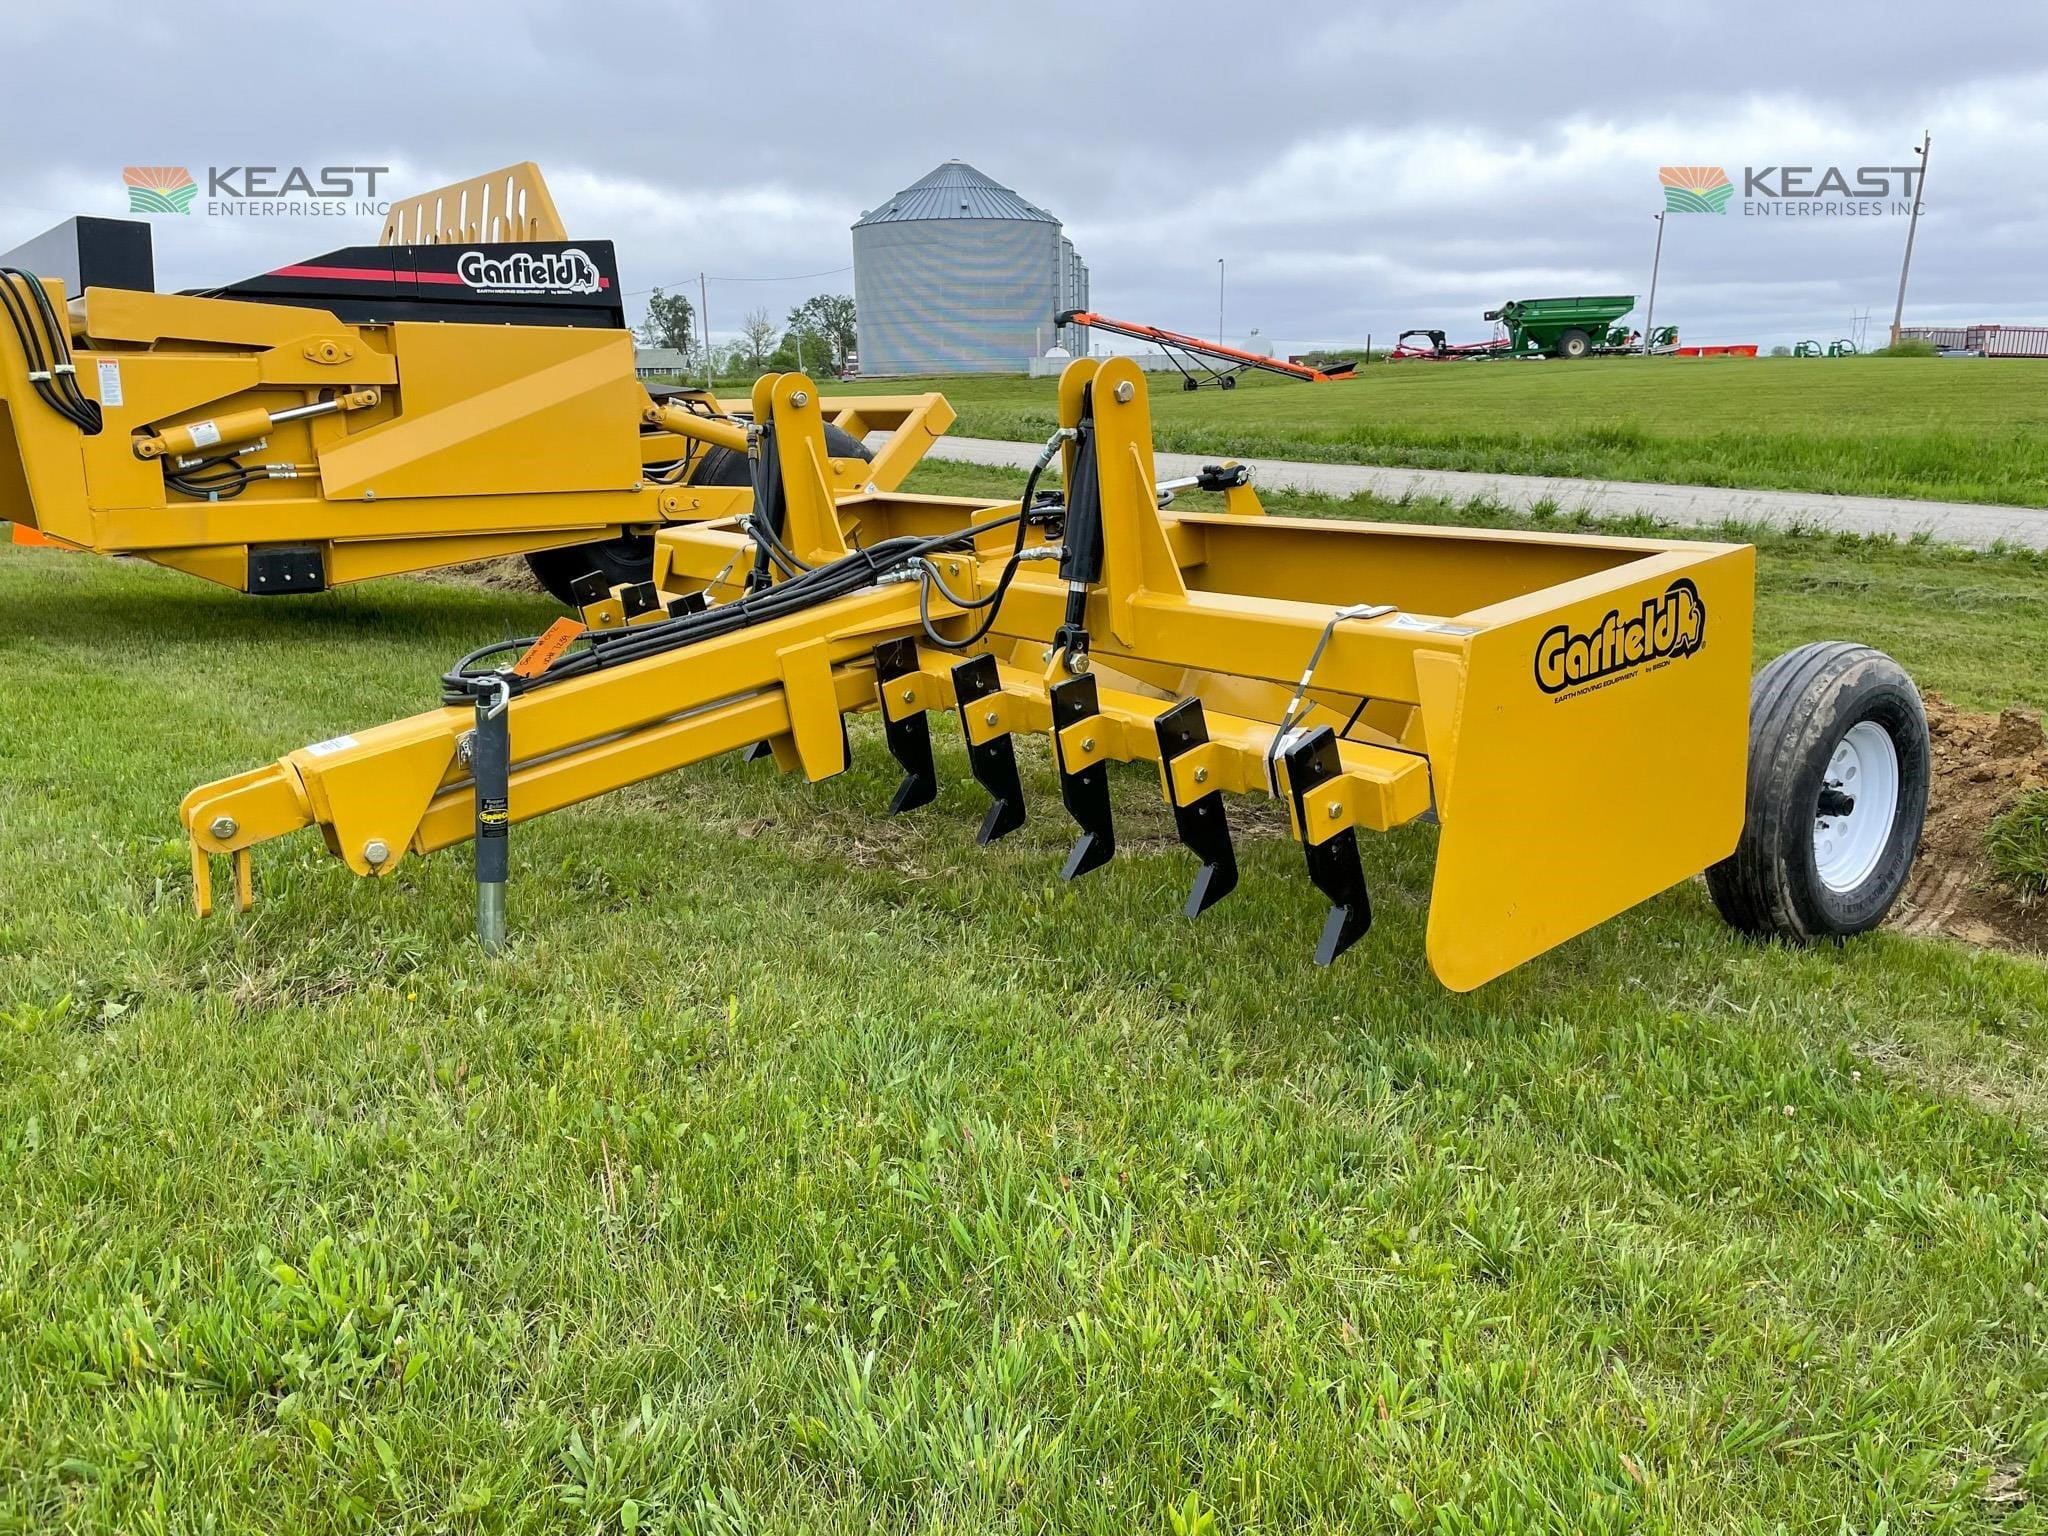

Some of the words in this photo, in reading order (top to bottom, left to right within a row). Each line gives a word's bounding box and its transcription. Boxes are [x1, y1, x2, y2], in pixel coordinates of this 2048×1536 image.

[457, 251, 578, 289] Garfield
[1535, 589, 1681, 694] Garfield
[1554, 691, 1577, 704] EARTH
[1576, 682, 1603, 697] MOVING
[1602, 670, 1639, 688] EQUIPMENT
[1652, 659, 1671, 671] BISON
